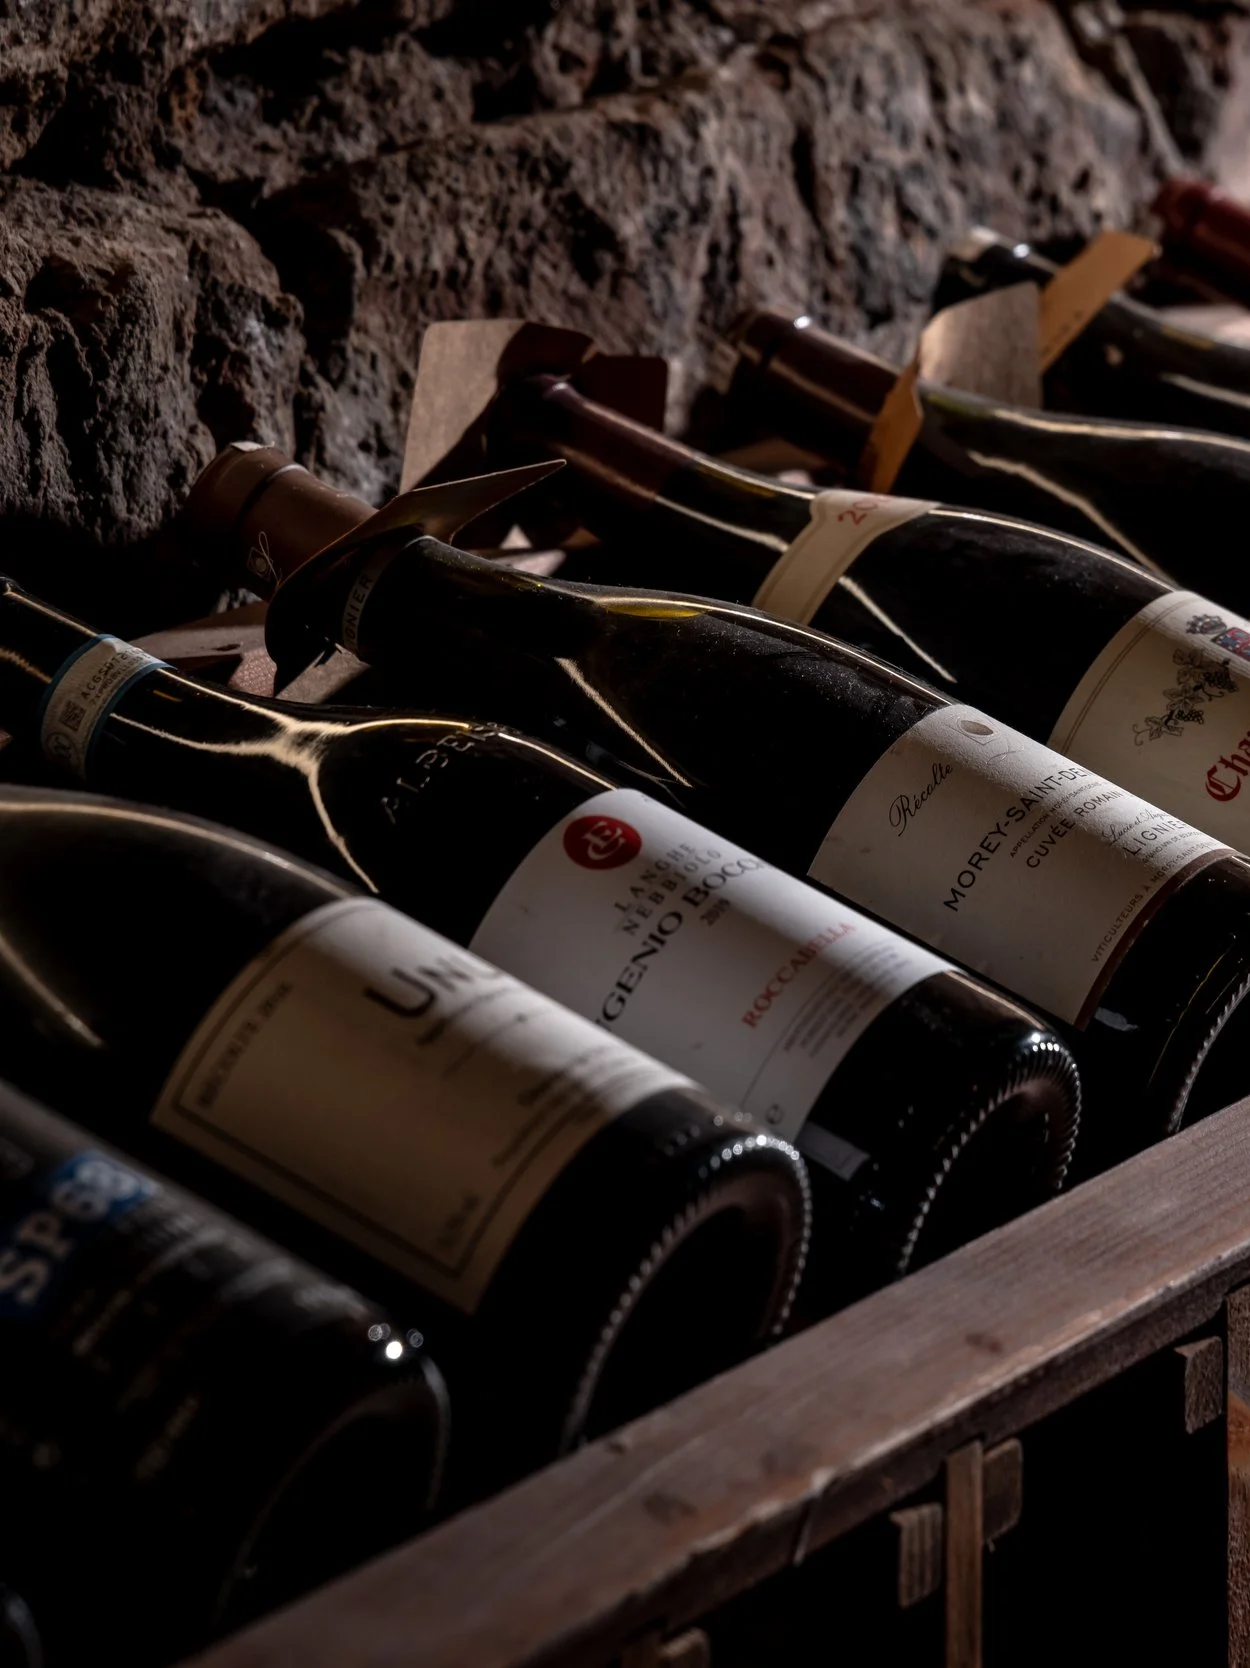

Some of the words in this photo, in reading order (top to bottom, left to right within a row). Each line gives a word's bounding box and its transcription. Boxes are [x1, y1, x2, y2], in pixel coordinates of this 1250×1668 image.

[888, 763, 954, 837] Récolte
[943, 767, 1091, 912] MOREY-SAINT-DE
[1026, 818, 1077, 869] CUVÉE
[1123, 820, 1186, 857] LIGNIE
[614, 843, 698, 913] LANGHE
[622, 848, 723, 937] NEBBIOLO
[596, 910, 684, 1030] GENIO
[681, 858, 770, 909] BOCC
[1090, 893, 1144, 963] VITICULTEURS
